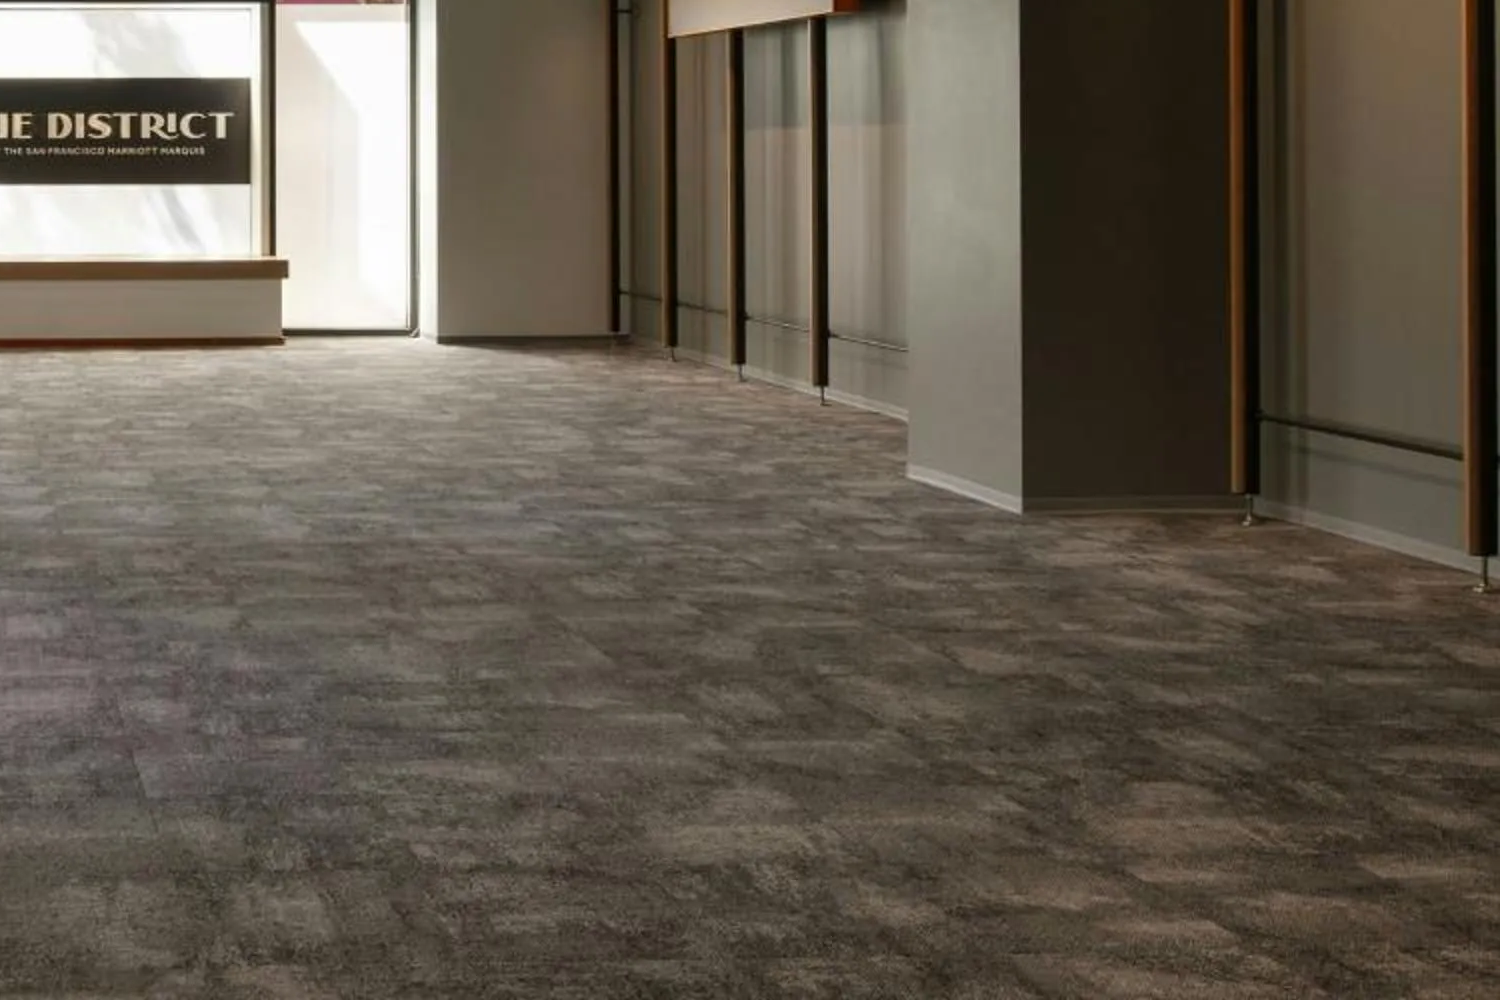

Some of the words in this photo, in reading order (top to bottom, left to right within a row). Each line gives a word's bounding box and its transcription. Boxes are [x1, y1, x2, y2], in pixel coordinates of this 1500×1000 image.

[47, 111, 236, 140] DISTRICT
[3, 146, 23, 156] THE
[25, 146, 46, 156] SAN
